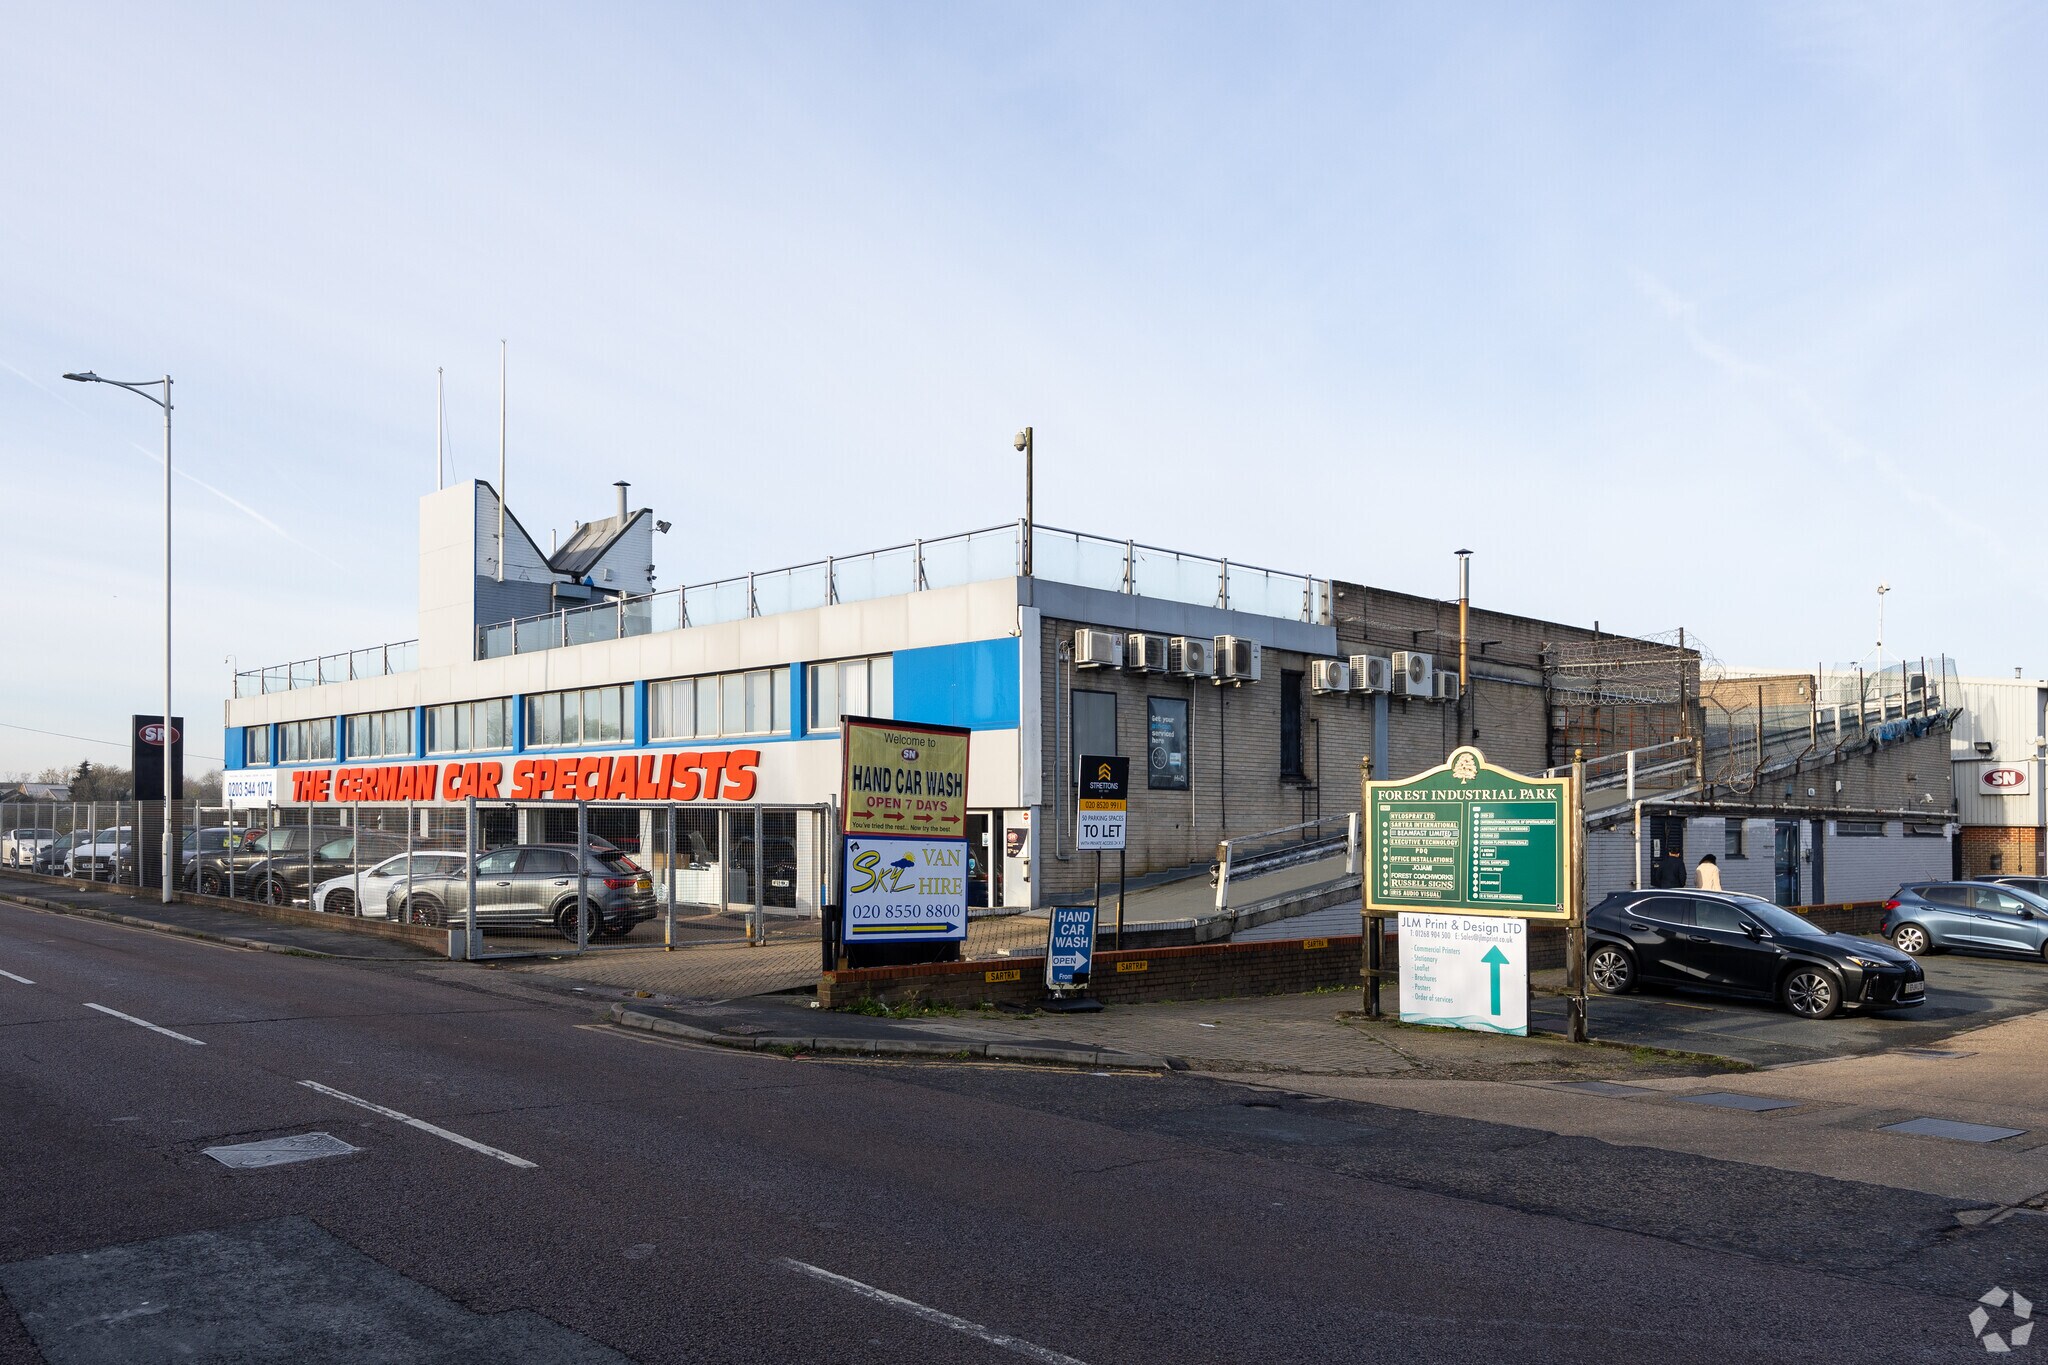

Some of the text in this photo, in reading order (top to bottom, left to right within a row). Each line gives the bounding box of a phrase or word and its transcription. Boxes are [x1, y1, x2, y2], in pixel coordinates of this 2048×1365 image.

[1152, 730, 1174, 738] serviced
[884, 732, 936, 748] Welcome to
[903, 750, 916, 759] SN
[292, 750, 761, 803] THE GERMAN CAR SPECIALISTS
[853, 764, 962, 798] HAND CAR WASH
[1992, 771, 2016, 785] SN
[228, 782, 272, 796] 0203 544 1074
[1090, 782, 1118, 790] STRETTONS
[1378, 788, 1557, 800] FOREST INDUSTRIAL PARK
[866, 796, 948, 812] OPEN 7 DAYS
[1084, 824, 1122, 838] TO LET
[922, 848, 961, 866] VAN
[918, 878, 962, 896] HIRE
[1391, 879, 1453, 890] RUSSELL SIGNS
[852, 904, 960, 918] 020 8550 8800
[1058, 912, 1090, 922] HAND
[1061, 924, 1085, 935] CAR
[1402, 917, 1522, 935] JLM Print & Design LTD
[1415, 930, 1430, 938] 01268
[1055, 937, 1088, 948] WASH
[1307, 940, 1325, 948] SARTRA
[1414, 945, 1460, 955] Commercial Printers
[1120, 962, 1142, 971] SARTRA
[1414, 964, 1430, 972] Leaflet
[991, 972, 1014, 980] SARTRA
[1414, 974, 1437, 982] Brochures
[1414, 983, 1431, 991] Posters
[1415, 993, 1453, 1004] Order of services
